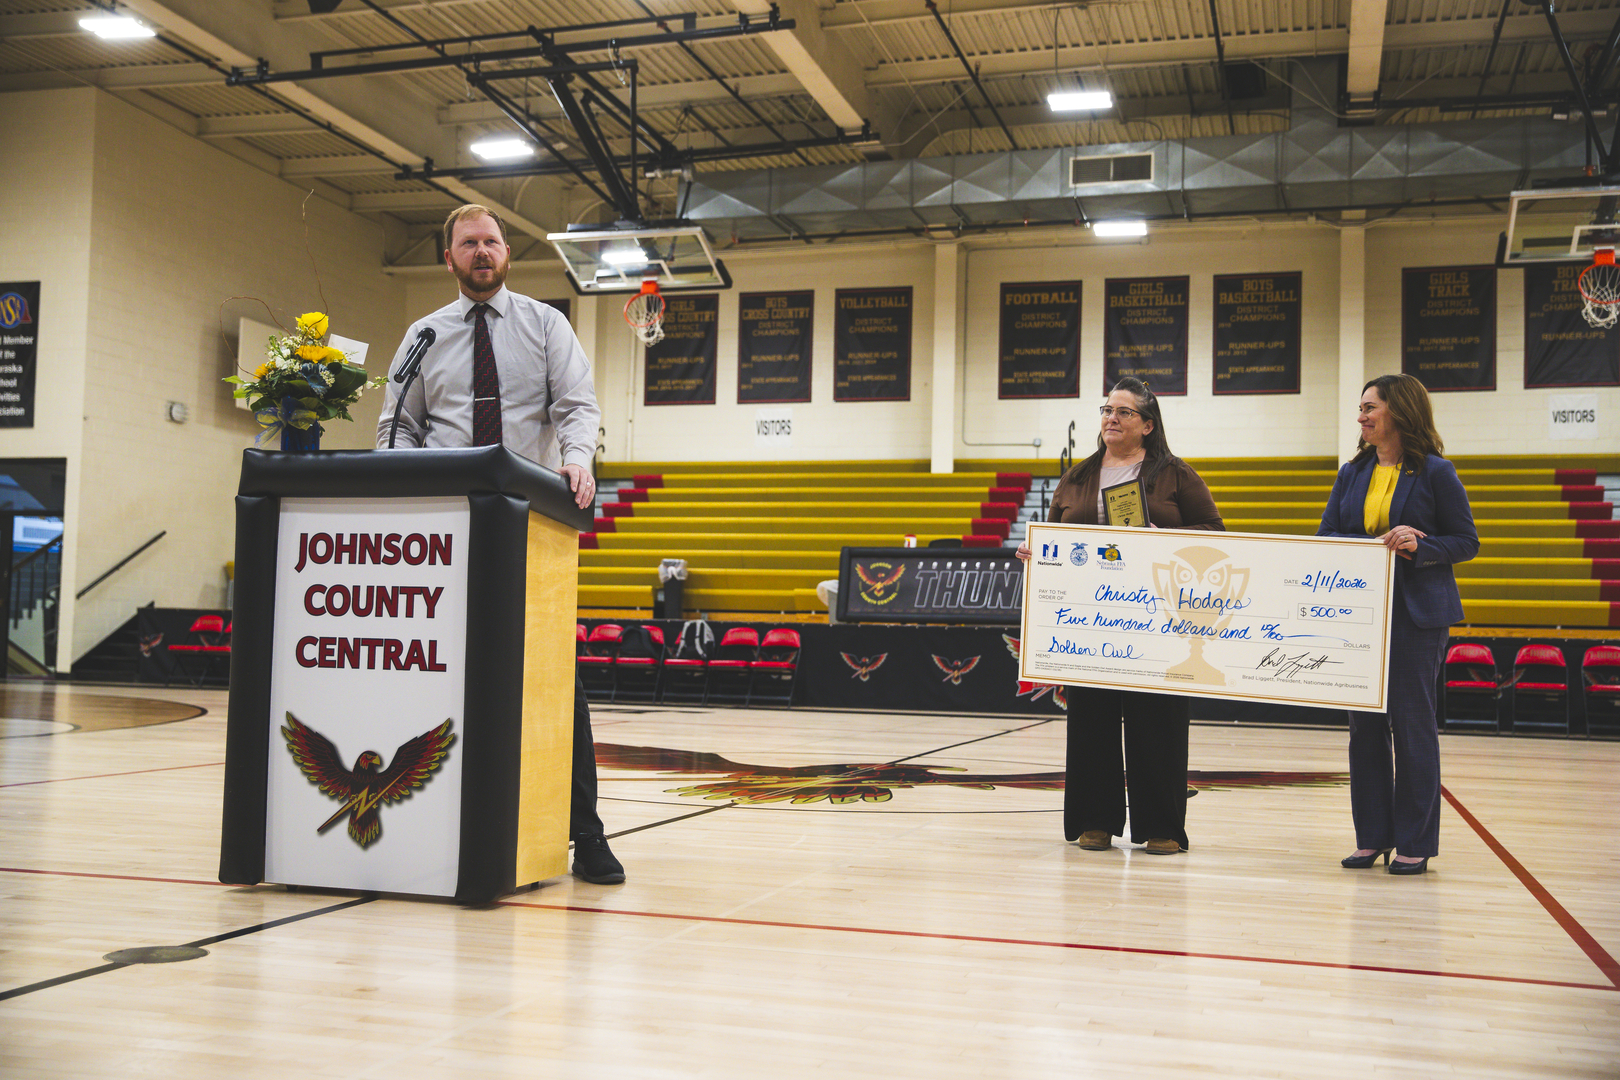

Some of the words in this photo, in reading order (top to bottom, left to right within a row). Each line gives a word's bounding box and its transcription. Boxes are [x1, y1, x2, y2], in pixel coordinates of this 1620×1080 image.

[1430, 271, 1468, 285] GIRLS
[1129, 282, 1164, 295] GIRLS
[1243, 279, 1273, 291] BOYS
[1428, 285, 1470, 297] TRACK
[1005, 292, 1077, 305] FOOTBALL
[1110, 294, 1185, 307] BASKETBALL
[1219, 290, 1297, 304] BASKETBALL
[670, 301, 695, 311] GIRLS
[765, 297, 787, 308] BOYS
[840, 296, 908, 309] VOLLEYBALL
[1427, 299, 1472, 308] DISTRICT
[743, 309, 769, 320] CROSS
[771, 308, 810, 319] COUNTRY
[1127, 308, 1167, 317] DISTRICT
[1237, 305, 1278, 314] DISTRICT
[1420, 307, 1480, 317] CHAMPIONS
[1021, 312, 1060, 321] DISTRICT
[1120, 316, 1174, 325] CHAMPIONS
[1230, 313, 1286, 322] CHAMPIONS
[758, 320, 794, 329] DISTRICT
[855, 318, 892, 326] DISTRICT
[1014, 320, 1067, 329] CHAMPIONS
[752, 328, 799, 336] CHAMPIONS
[848, 325, 898, 333] CHAMPIONS
[3, 335, 34, 345] Member
[1419, 337, 1480, 345] RUNNER-UPS
[1541, 331, 1605, 341] RUNNER-UPS
[1119, 344, 1174, 352] RUNNER-UPS
[1229, 341, 1286, 350] RUNNER-UPS
[1013, 347, 1066, 355] RUNNER-UPS
[1245, 365, 1285, 373] APPEARANCES
[1552, 409, 1595, 423] VISITORS
[756, 420, 791, 436] VISITORS
[294, 532, 453, 573] JOHNSON
[1301, 570, 1367, 593] 2/11/2026
[914, 570, 1023, 609] THUN
[304, 583, 445, 619] COUNTY
[1095, 584, 1165, 614] Christy
[1178, 587, 1252, 616] Hodges
[1055, 608, 1089, 625] Five
[1093, 612, 1155, 632] hundred
[1160, 617, 1218, 637] dollars
[1219, 626, 1252, 640] and
[1048, 636, 1097, 656] Golden
[1102, 642, 1144, 660] Owl
[1343, 642, 1371, 650] DOLLARS
[295, 635, 447, 672] CENTRAL
[1276, 677, 1302, 685] President,
[1303, 679, 1333, 687] Nationwide
[1334, 681, 1369, 690] Agribusiness
